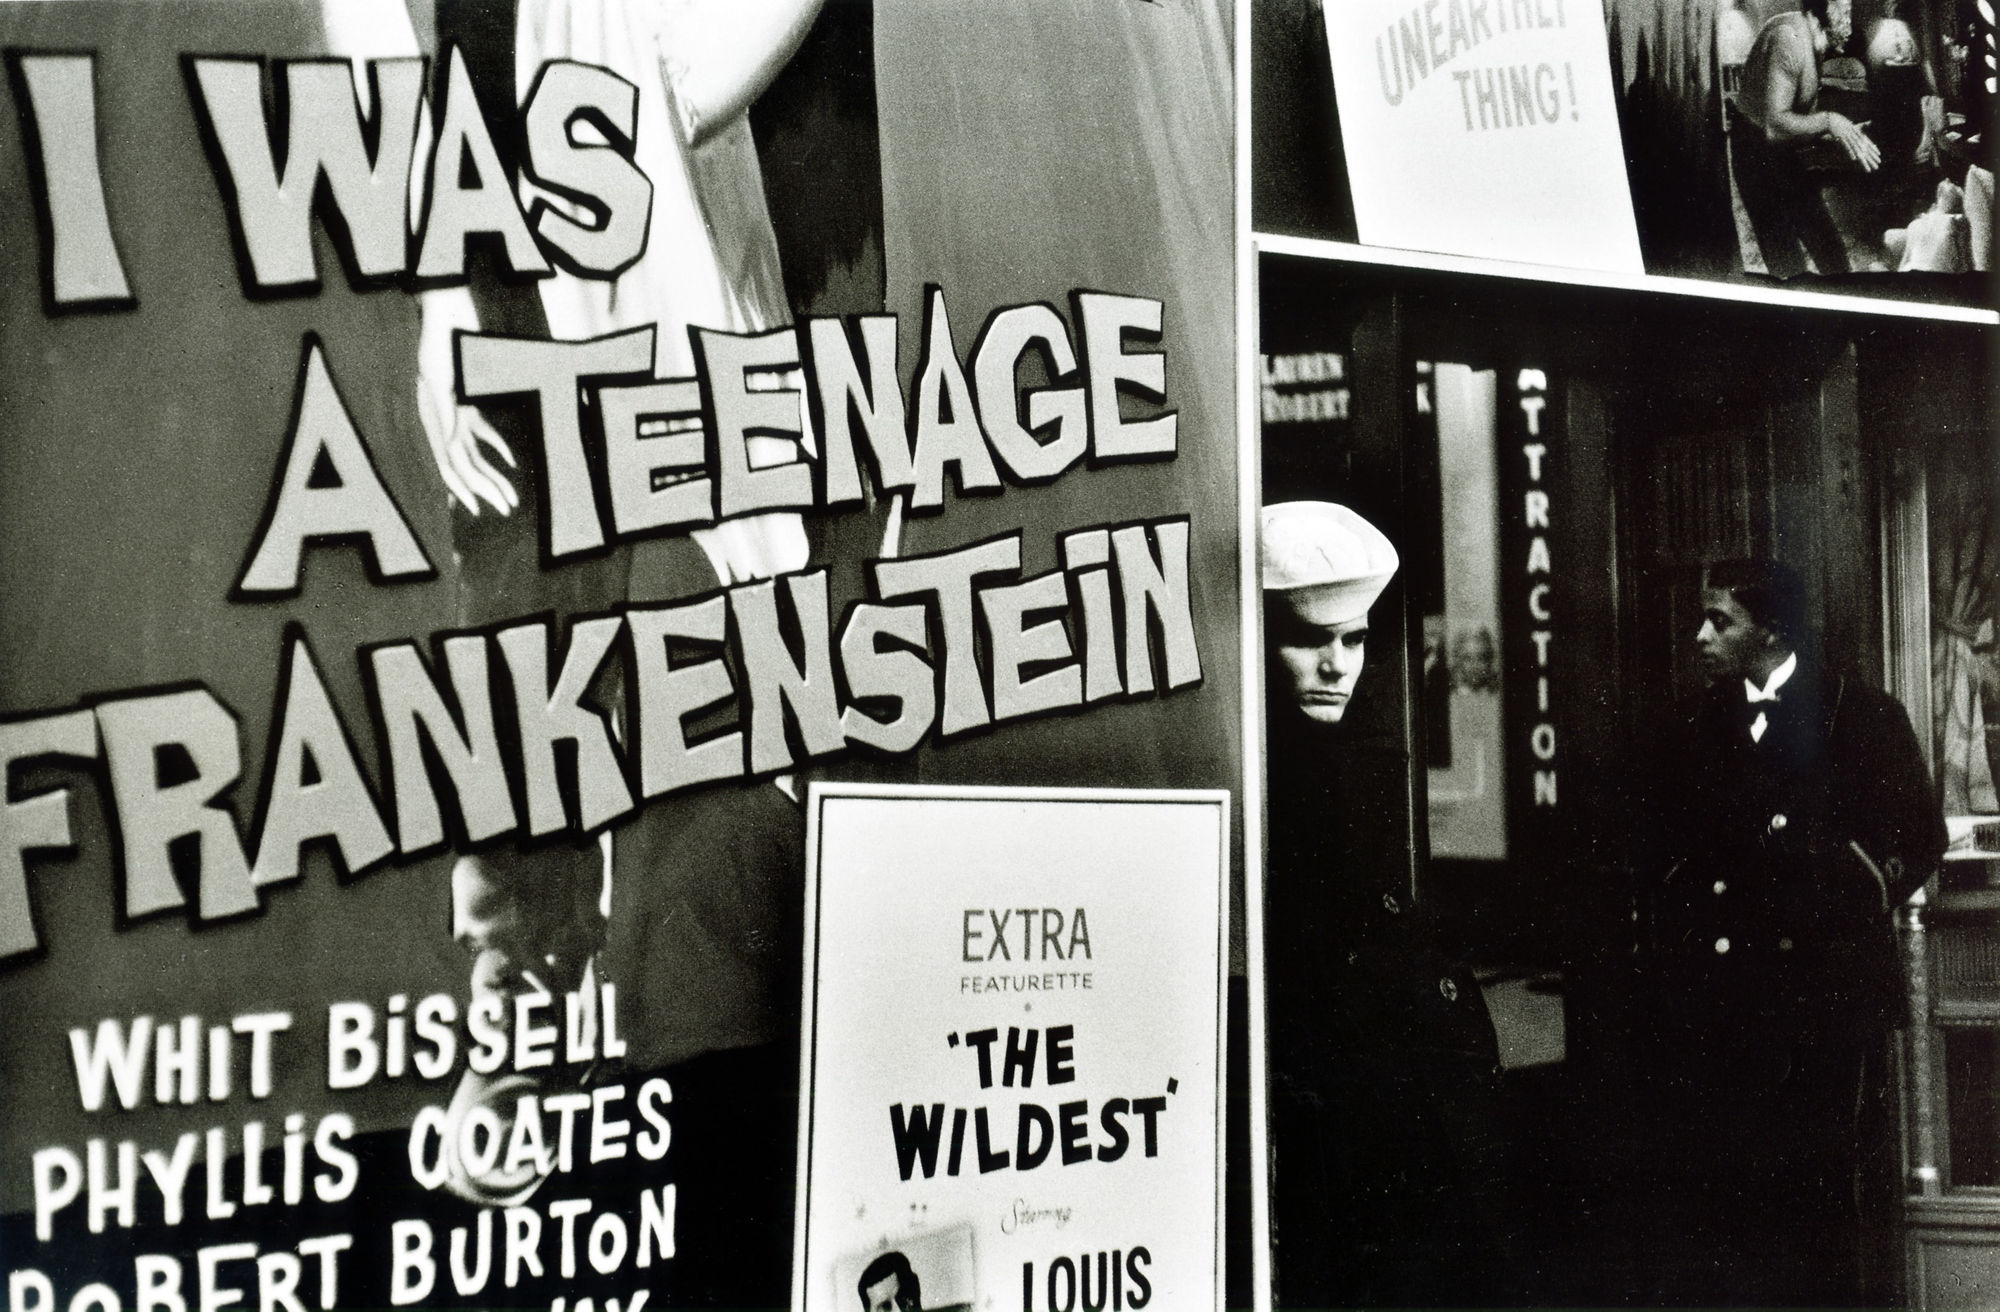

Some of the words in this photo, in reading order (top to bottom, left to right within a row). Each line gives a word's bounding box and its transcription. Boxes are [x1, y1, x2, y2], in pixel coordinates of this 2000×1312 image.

[1452, 61, 1579, 132] THING!
[5, 50, 138, 316] I
[182, 42, 654, 300] WAS
[229, 331, 438, 602] A
[454, 284, 1177, 566] TEENAGE
[1518, 368, 1557, 807] ATTRACTION
[960, 973, 1093, 994] FEATURETTE
[962, 908, 1093, 962] EXTRA
[69, 1012, 292, 1112] WHIT
[408, 1077, 672, 1190] COATES
[1022, 1246, 1152, 1312] LOUIS
